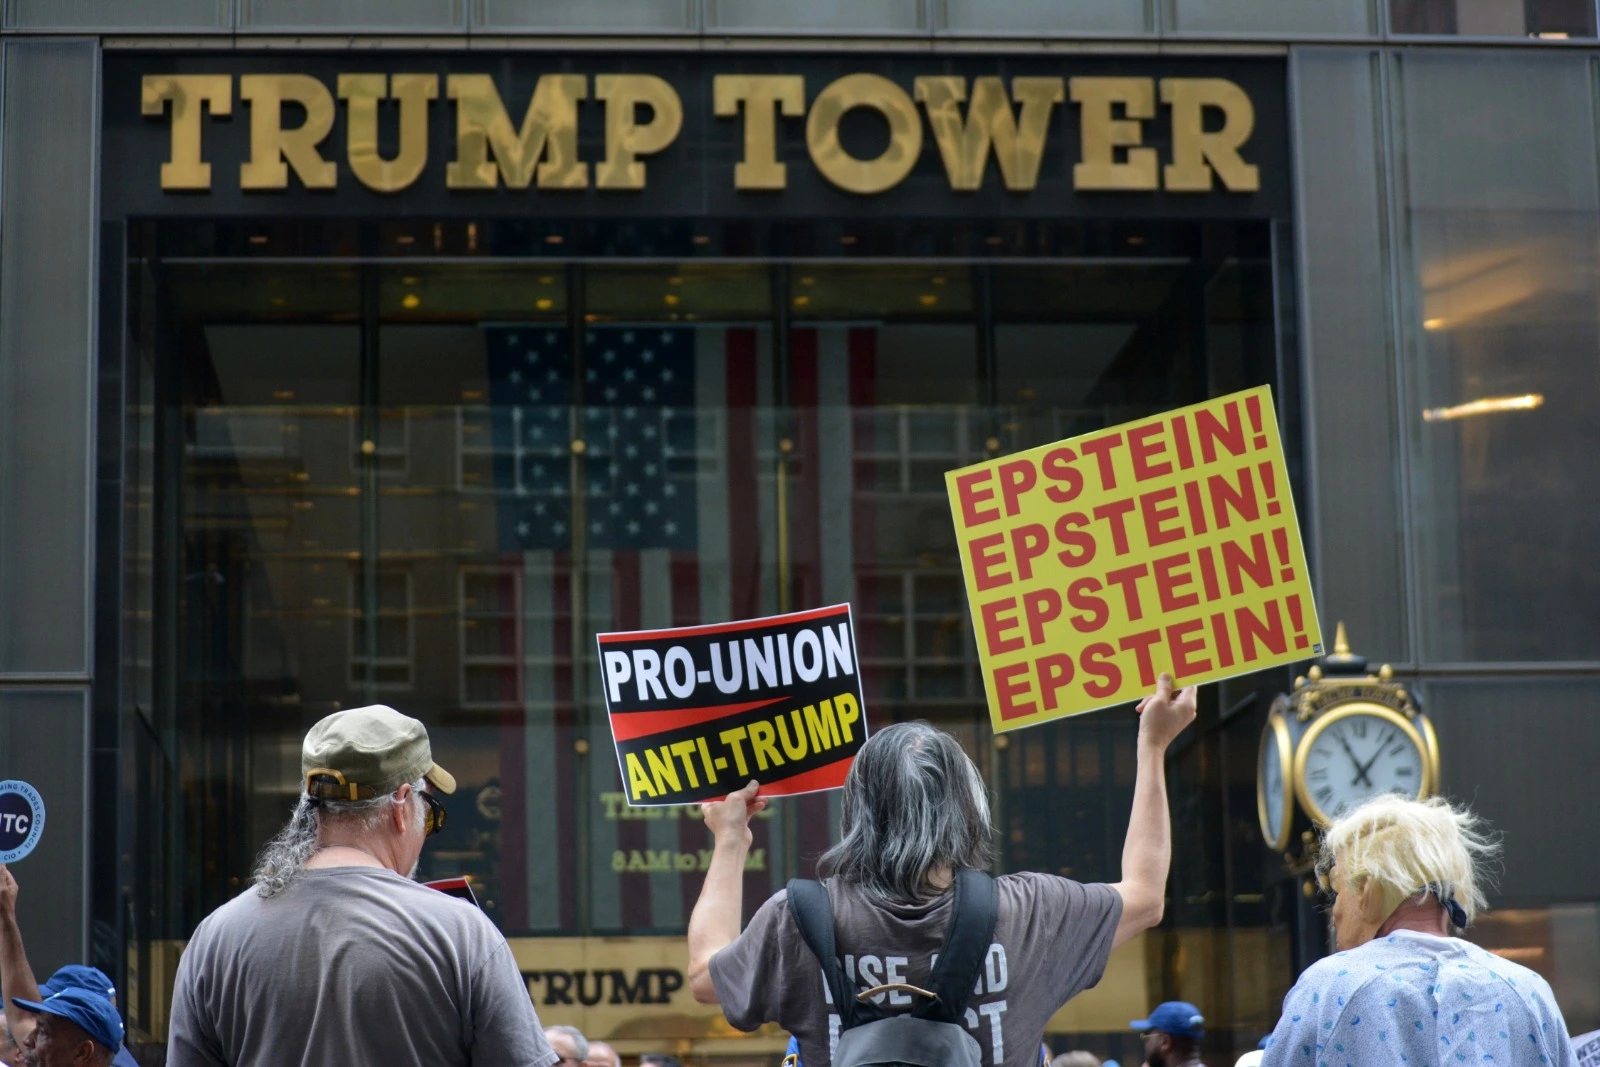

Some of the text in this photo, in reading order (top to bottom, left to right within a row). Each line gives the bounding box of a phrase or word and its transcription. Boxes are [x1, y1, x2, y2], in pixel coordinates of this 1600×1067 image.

[141, 72, 1260, 194] TRUMP TOWER
[956, 395, 1268, 528] EPSTEIN!
[968, 460, 1282, 592] EPSTEIN!
[980, 527, 1295, 657] EPSTEIN!
[604, 622, 854, 702] PRO-UNION
[992, 594, 1309, 722] EPSTEIN!
[20, 785, 40, 811] TRADES
[625, 692, 860, 800] ANTI-TRUMP
[0, 813, 29, 834] TC
[24, 813, 41, 849] COUNCIL
